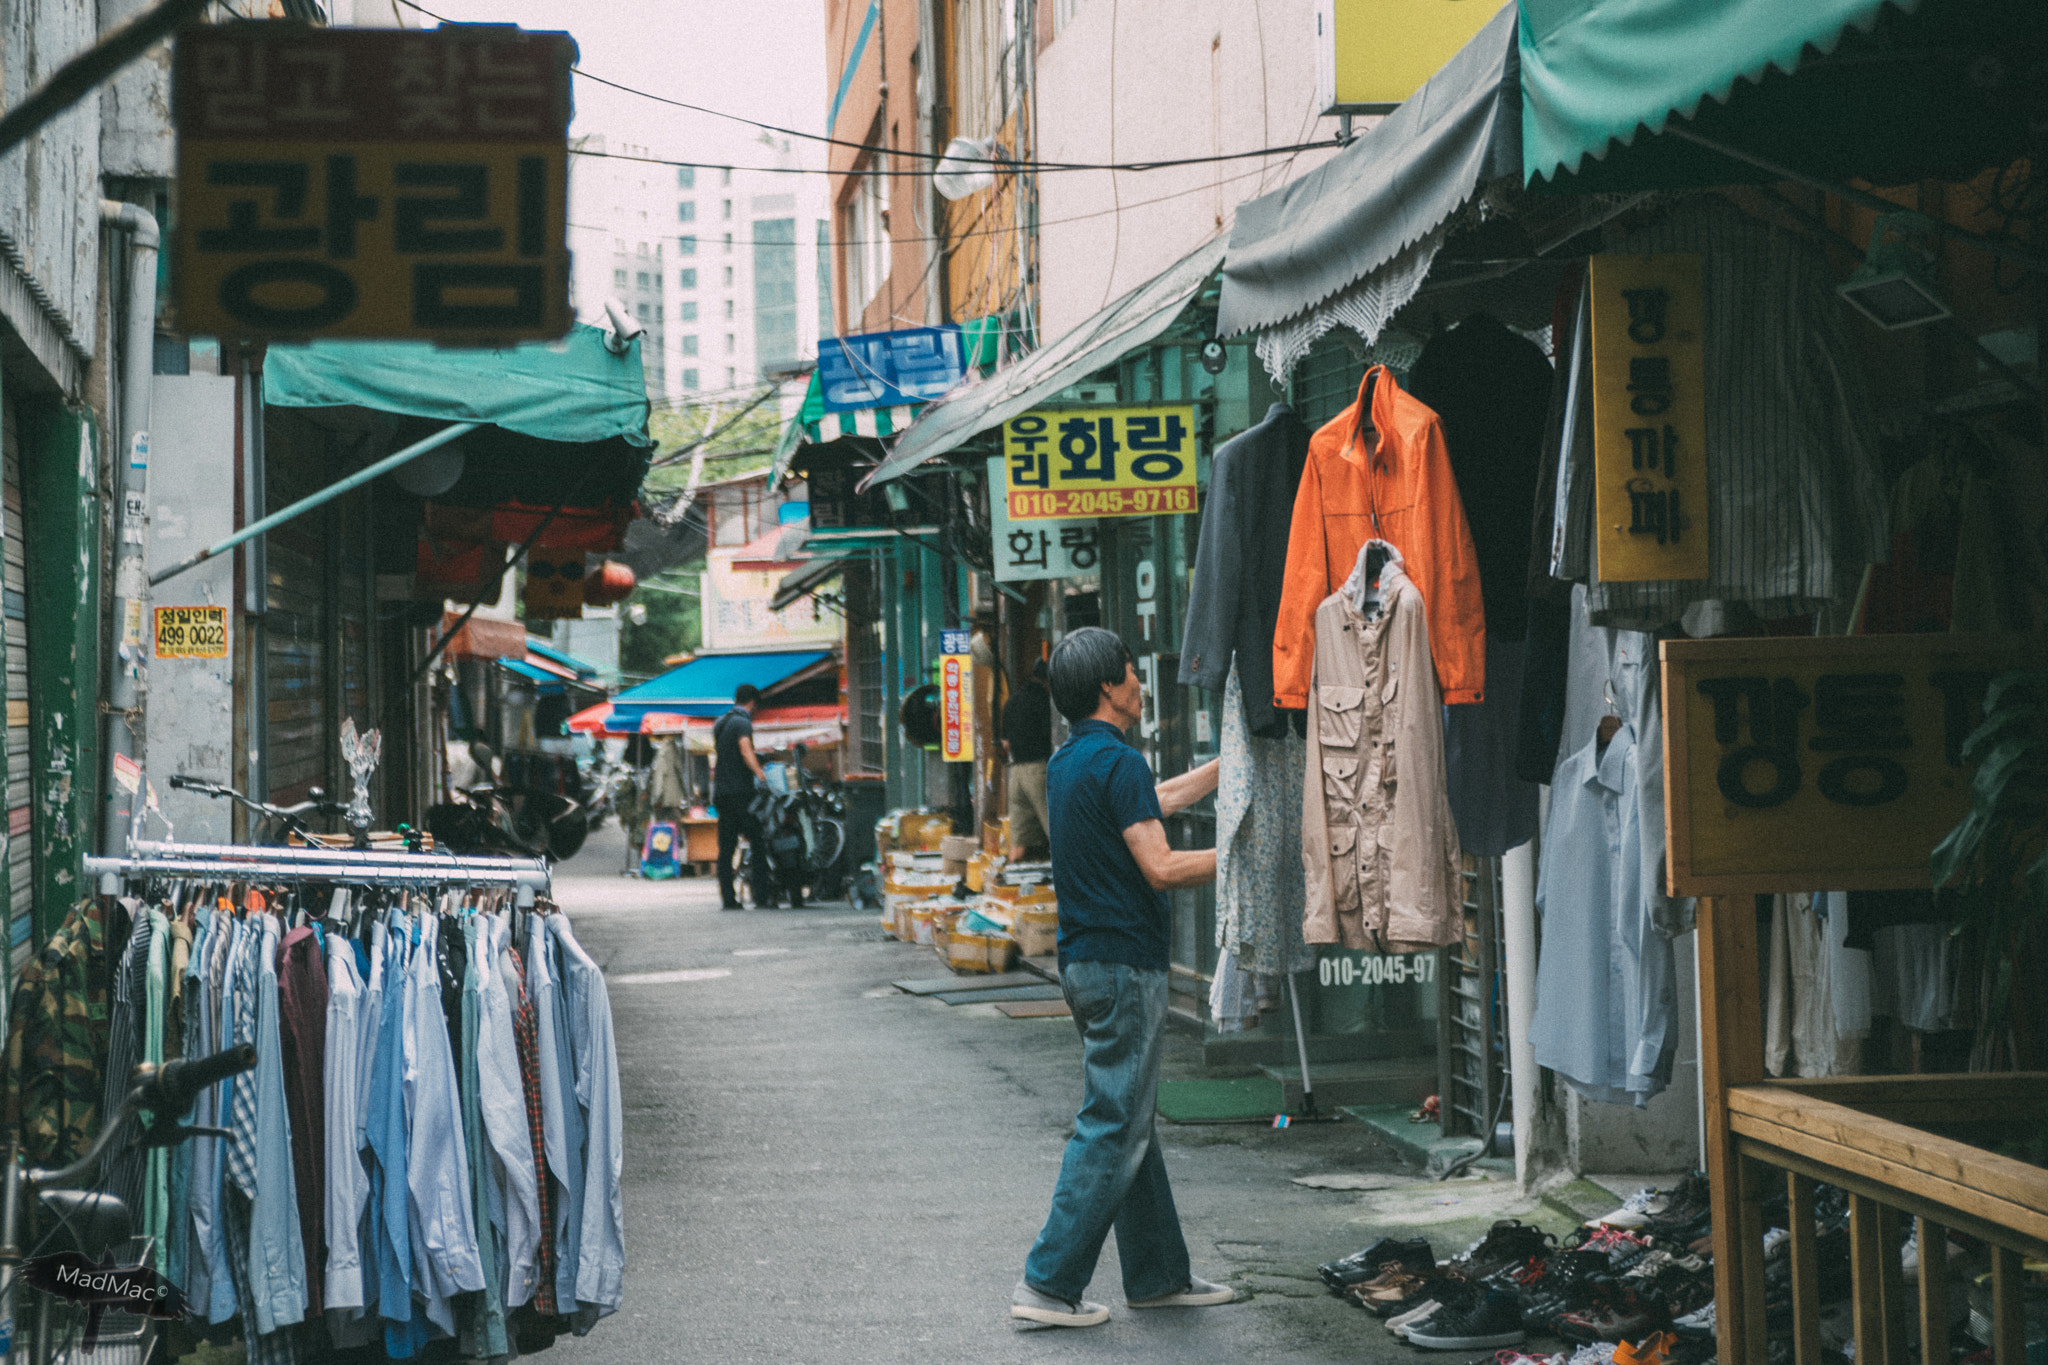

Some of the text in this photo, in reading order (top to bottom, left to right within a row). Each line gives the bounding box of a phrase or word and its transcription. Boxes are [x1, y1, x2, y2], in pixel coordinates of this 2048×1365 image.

[199, 40, 545, 131] 믿고 찾는
[199, 154, 547, 330] 광림
[819, 331, 962, 404] 광림
[1009, 415, 1050, 489] 우리
[1058, 415, 1187, 481] 화랑
[1014, 488, 1190, 516] 010-2045-9716
[160, 609, 223, 625] 성일인력
[943, 633, 971, 654] 광림
[1319, 954, 1435, 986] 010-2045-97
